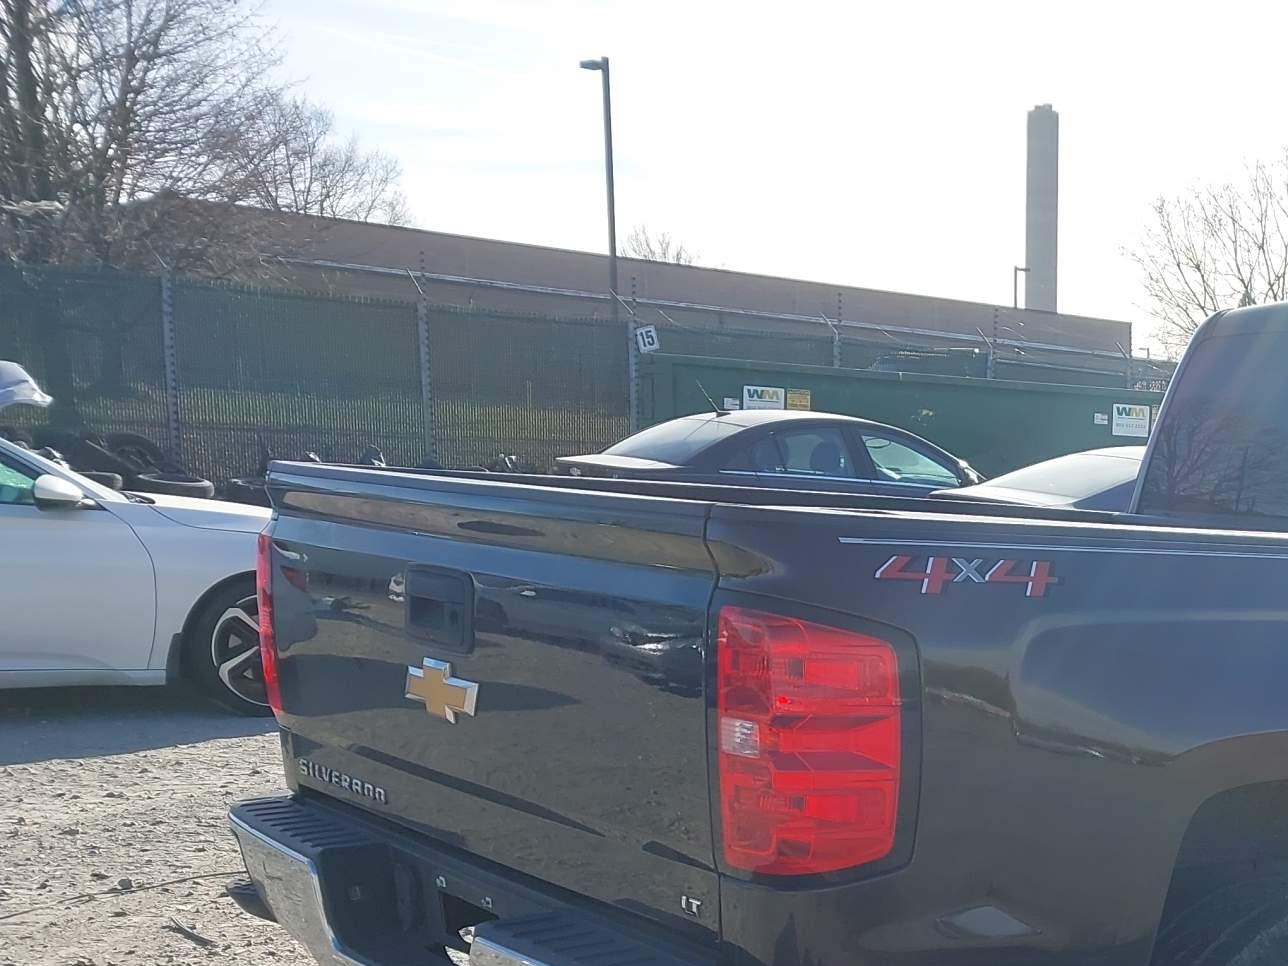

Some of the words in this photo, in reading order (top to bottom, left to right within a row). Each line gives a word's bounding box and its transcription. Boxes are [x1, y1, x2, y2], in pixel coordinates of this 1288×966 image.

[640, 330, 655, 348] 15
[746, 388, 780, 400] WM
[1115, 406, 1145, 417] WM
[299, 759, 386, 803] SILVERADO
[681, 895, 701, 915] LT
